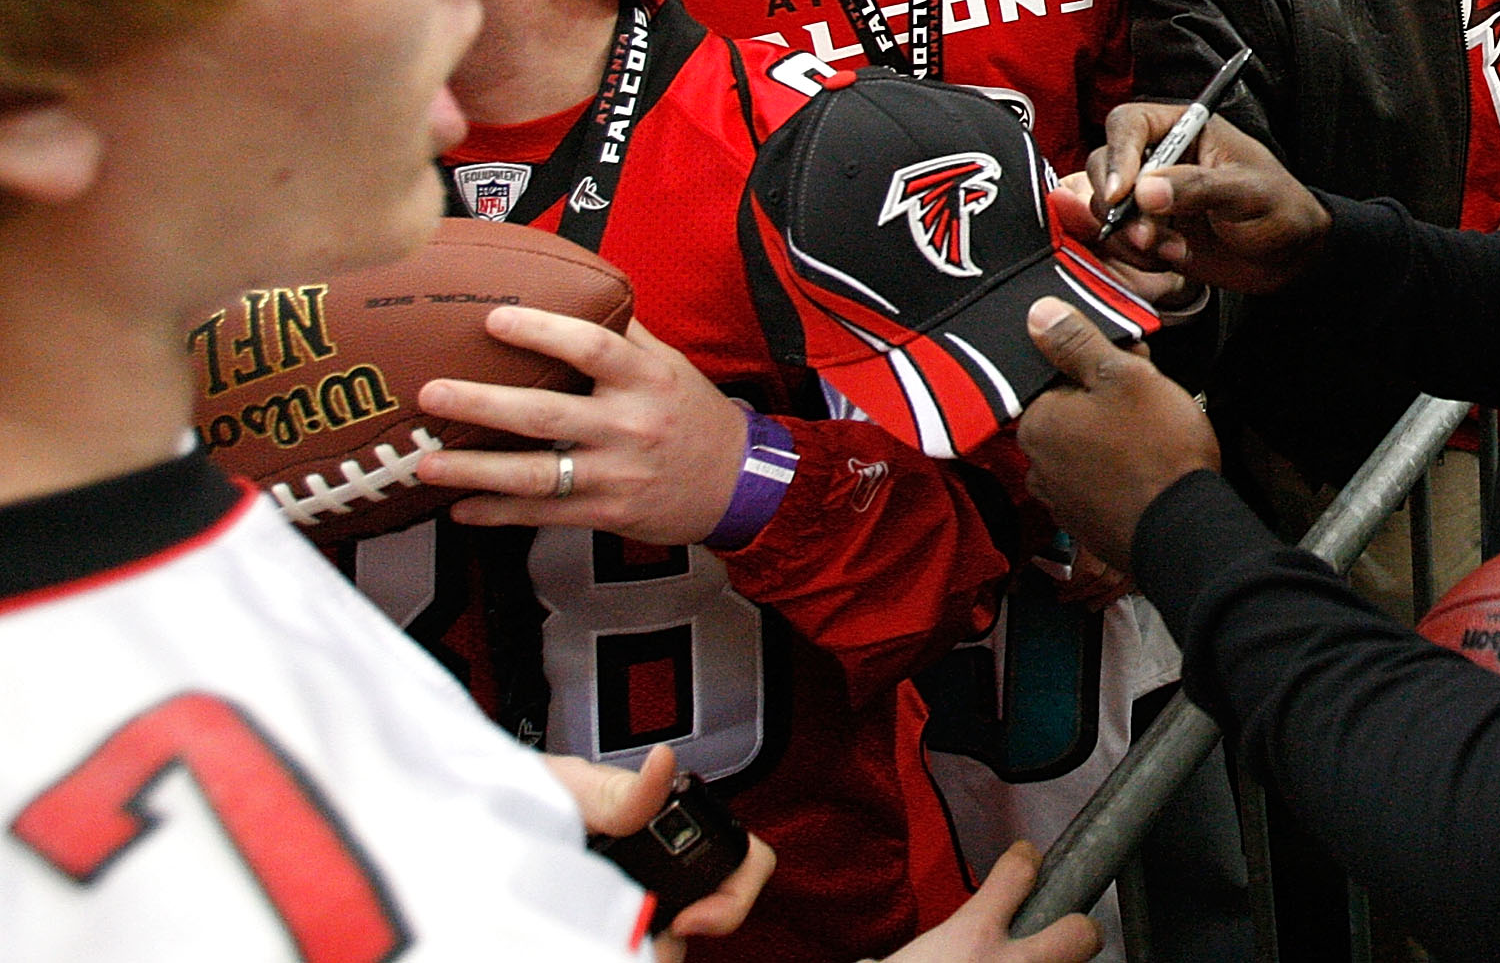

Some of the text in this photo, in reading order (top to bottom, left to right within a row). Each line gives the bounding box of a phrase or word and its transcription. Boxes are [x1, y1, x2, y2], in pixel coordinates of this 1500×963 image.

[595, 33, 630, 125] ATLANTA
[600, 7, 649, 164] FALCONS
[476, 197, 506, 215] NFL
[188, 284, 337, 398] NFL
[425, 294, 520, 306] OFFICIAL
[8, 688, 418, 963] 7
